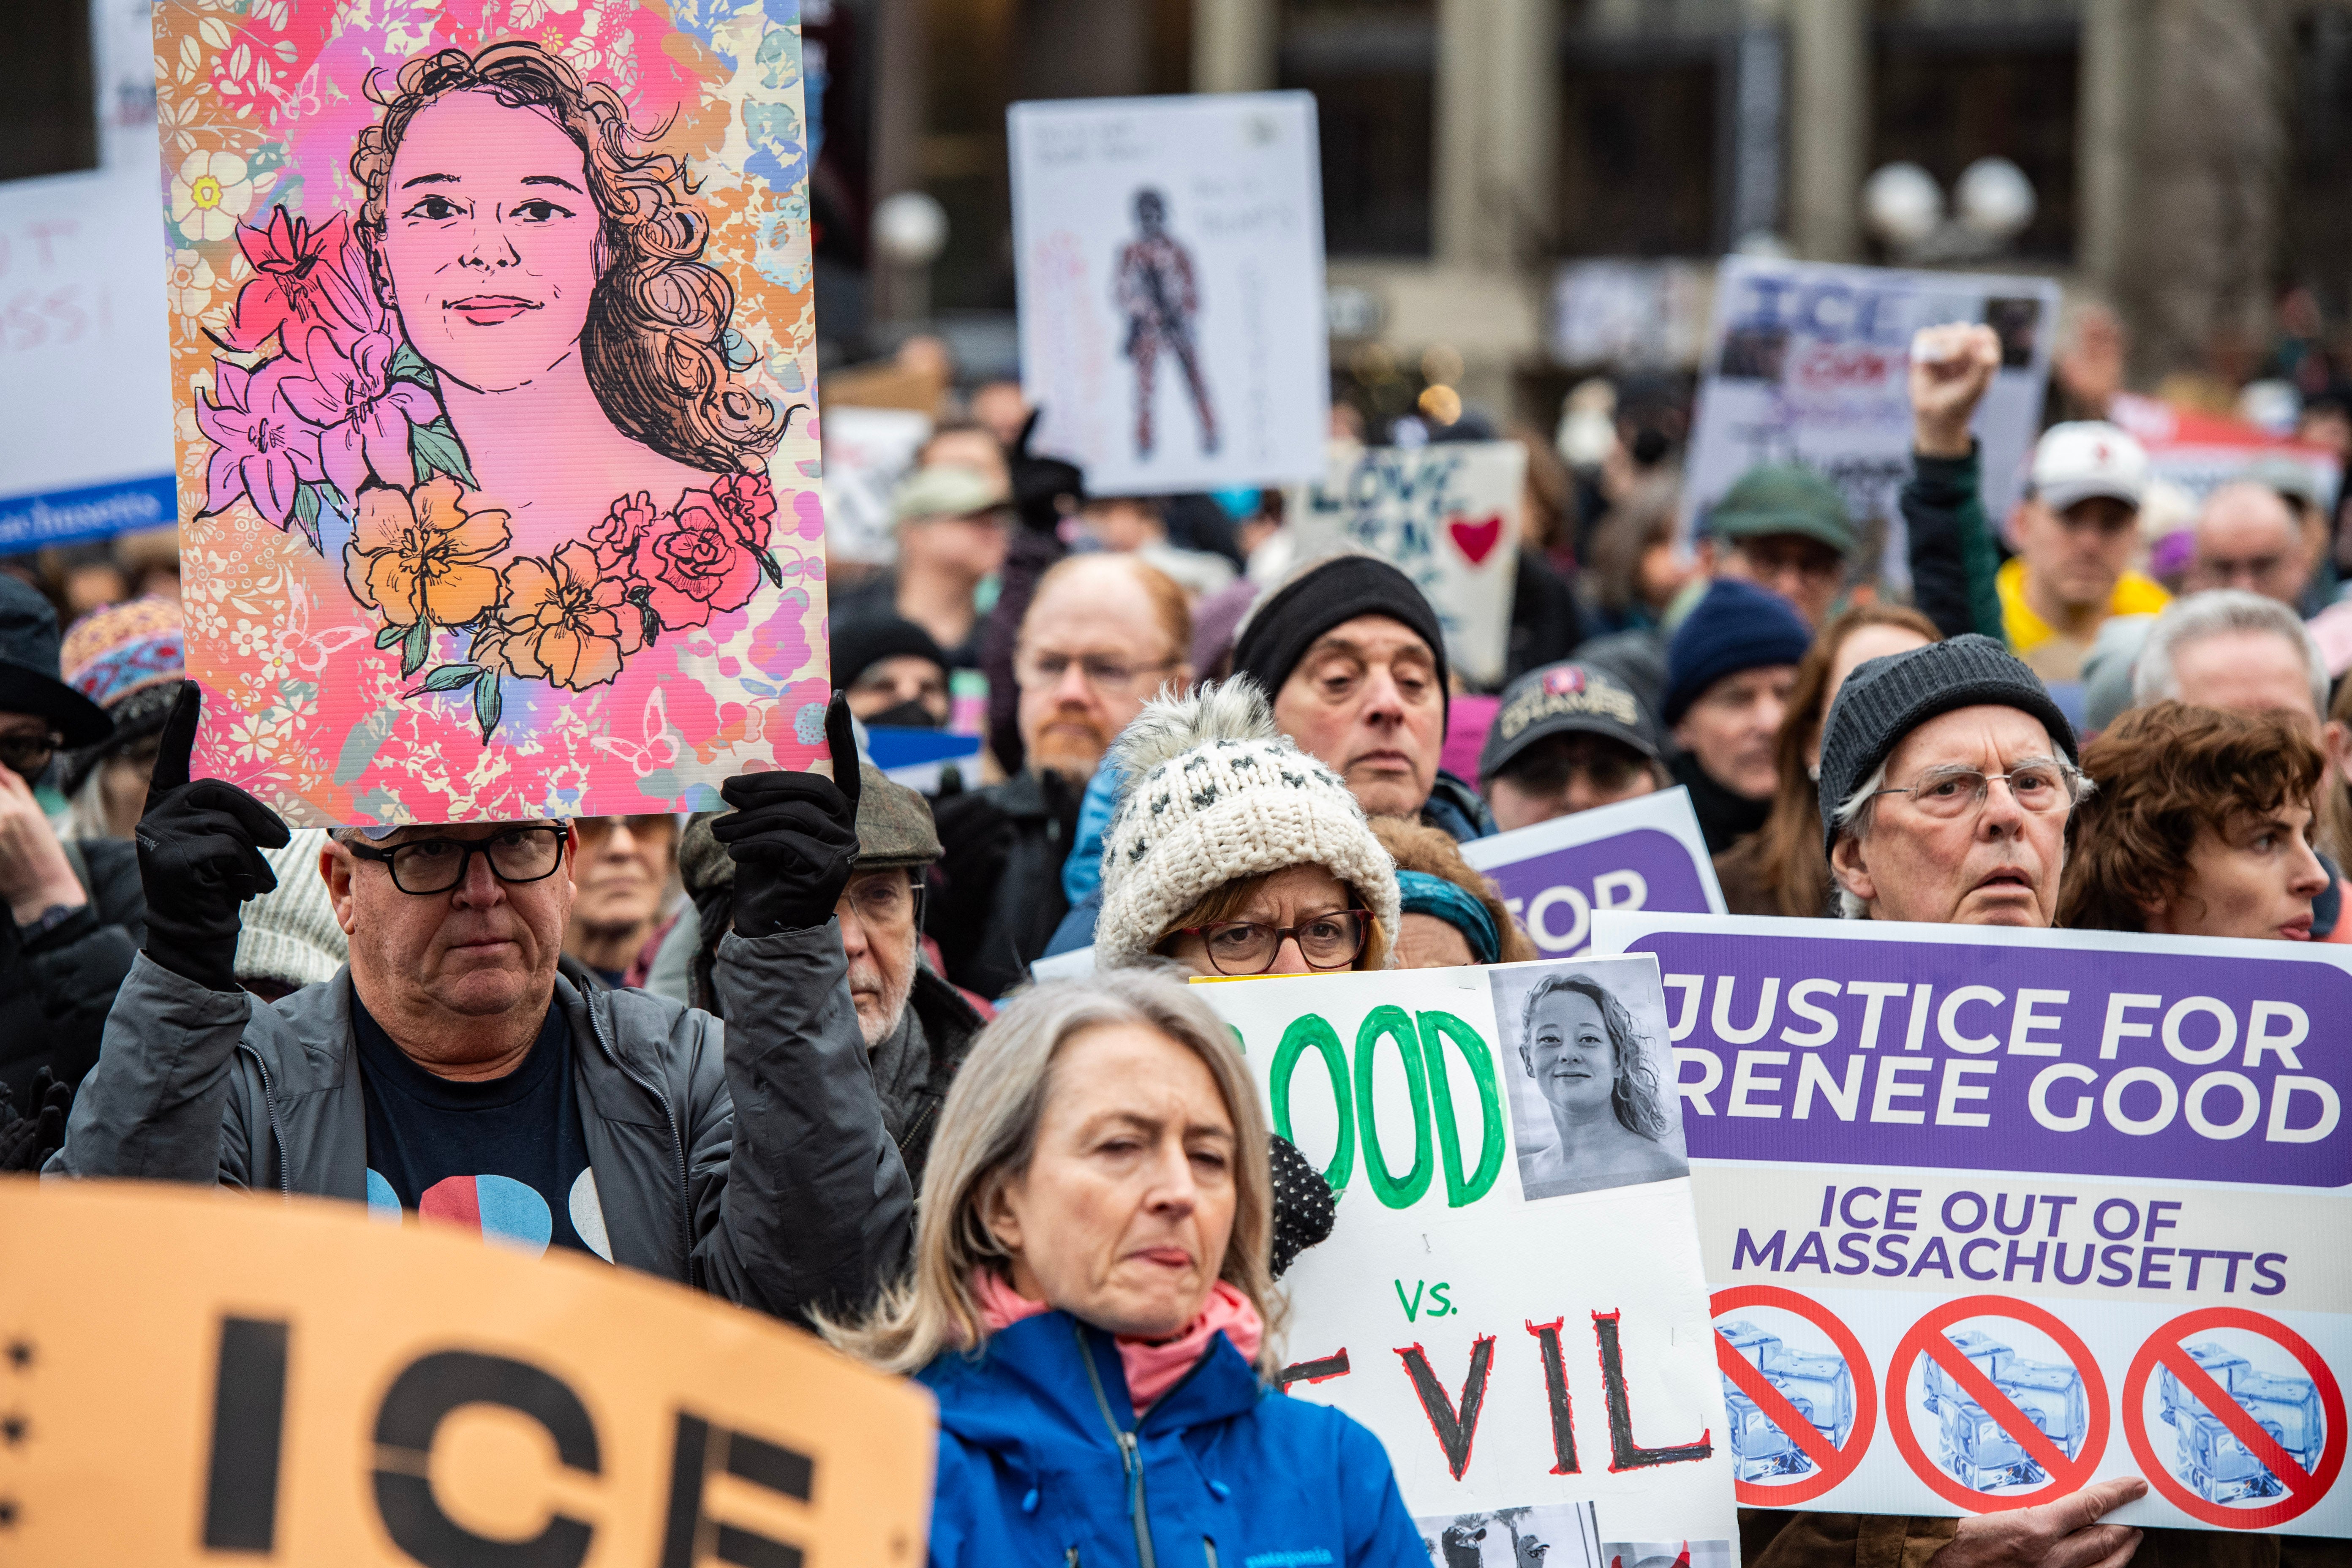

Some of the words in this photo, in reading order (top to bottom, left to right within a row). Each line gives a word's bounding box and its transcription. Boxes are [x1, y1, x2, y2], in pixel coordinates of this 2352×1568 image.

[1505, 869, 1648, 952] OR
[1663, 973, 2070, 1058] JUSTICE
[2100, 992, 2310, 1069] FOR
[1223, 1004, 1508, 1209] OOD
[1679, 1049, 1998, 1127] RENEE
[2028, 1063, 2341, 1144] GOOD
[1820, 1184, 1921, 1231] ICE
[1941, 1190, 2076, 1238] OUT
[2094, 1196, 2182, 1242] OF
[1732, 1228, 2288, 1297] MASSACHUSETTS
[199, 1312, 819, 1568] ICE
